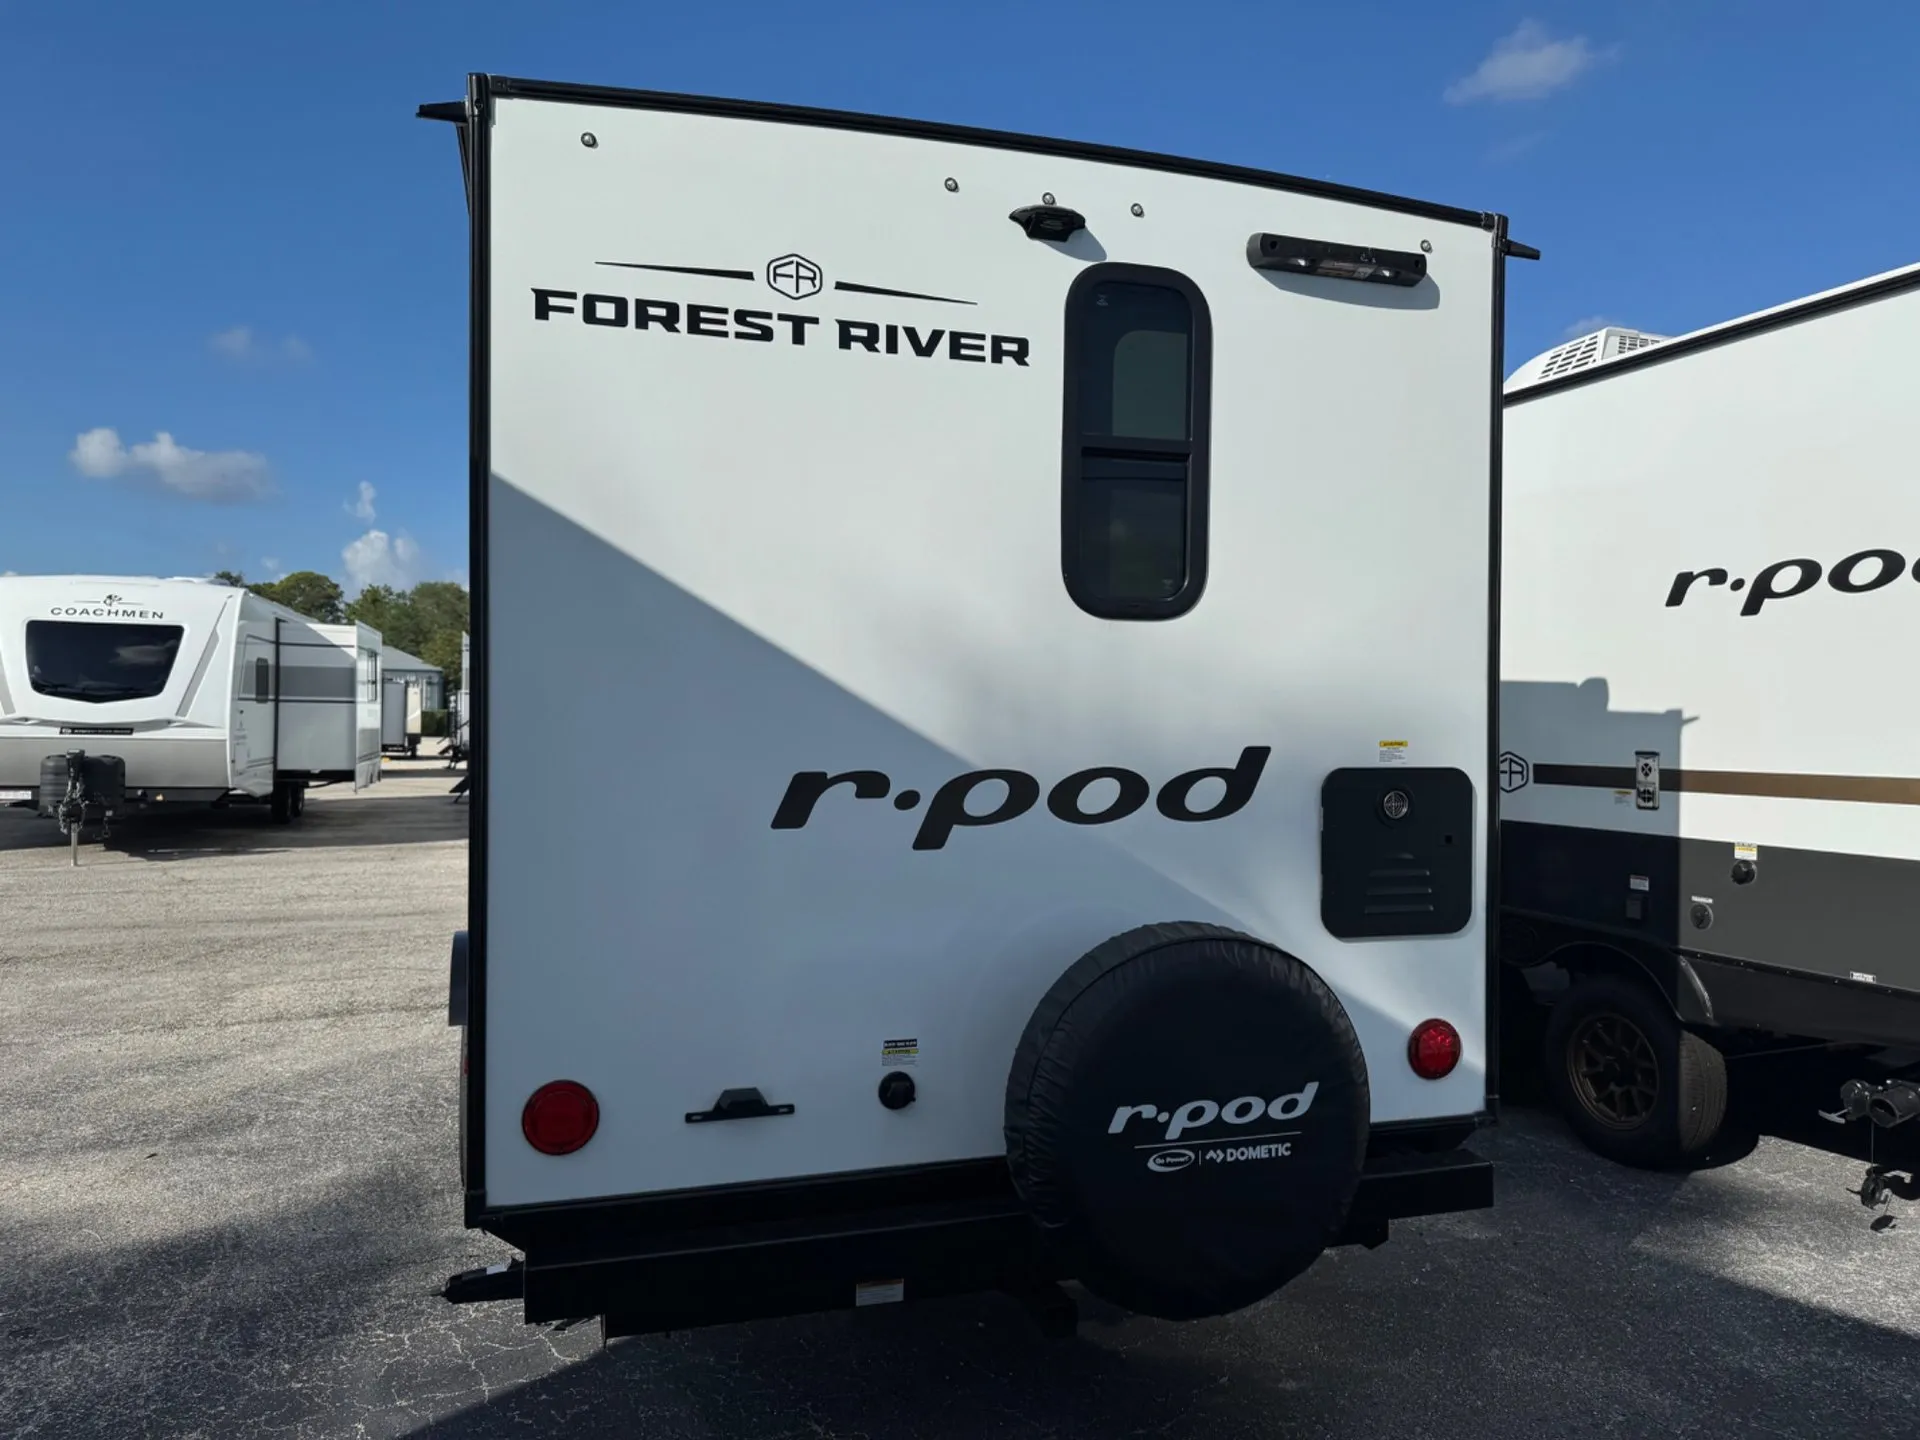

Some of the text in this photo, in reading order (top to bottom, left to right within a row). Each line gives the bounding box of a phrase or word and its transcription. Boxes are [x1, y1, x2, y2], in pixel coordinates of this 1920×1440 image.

[530, 287, 1030, 367] FOREST RIVER
[50, 607, 165, 619] COACHMEN
[1226, 1142, 1292, 1162] DOMETIC
